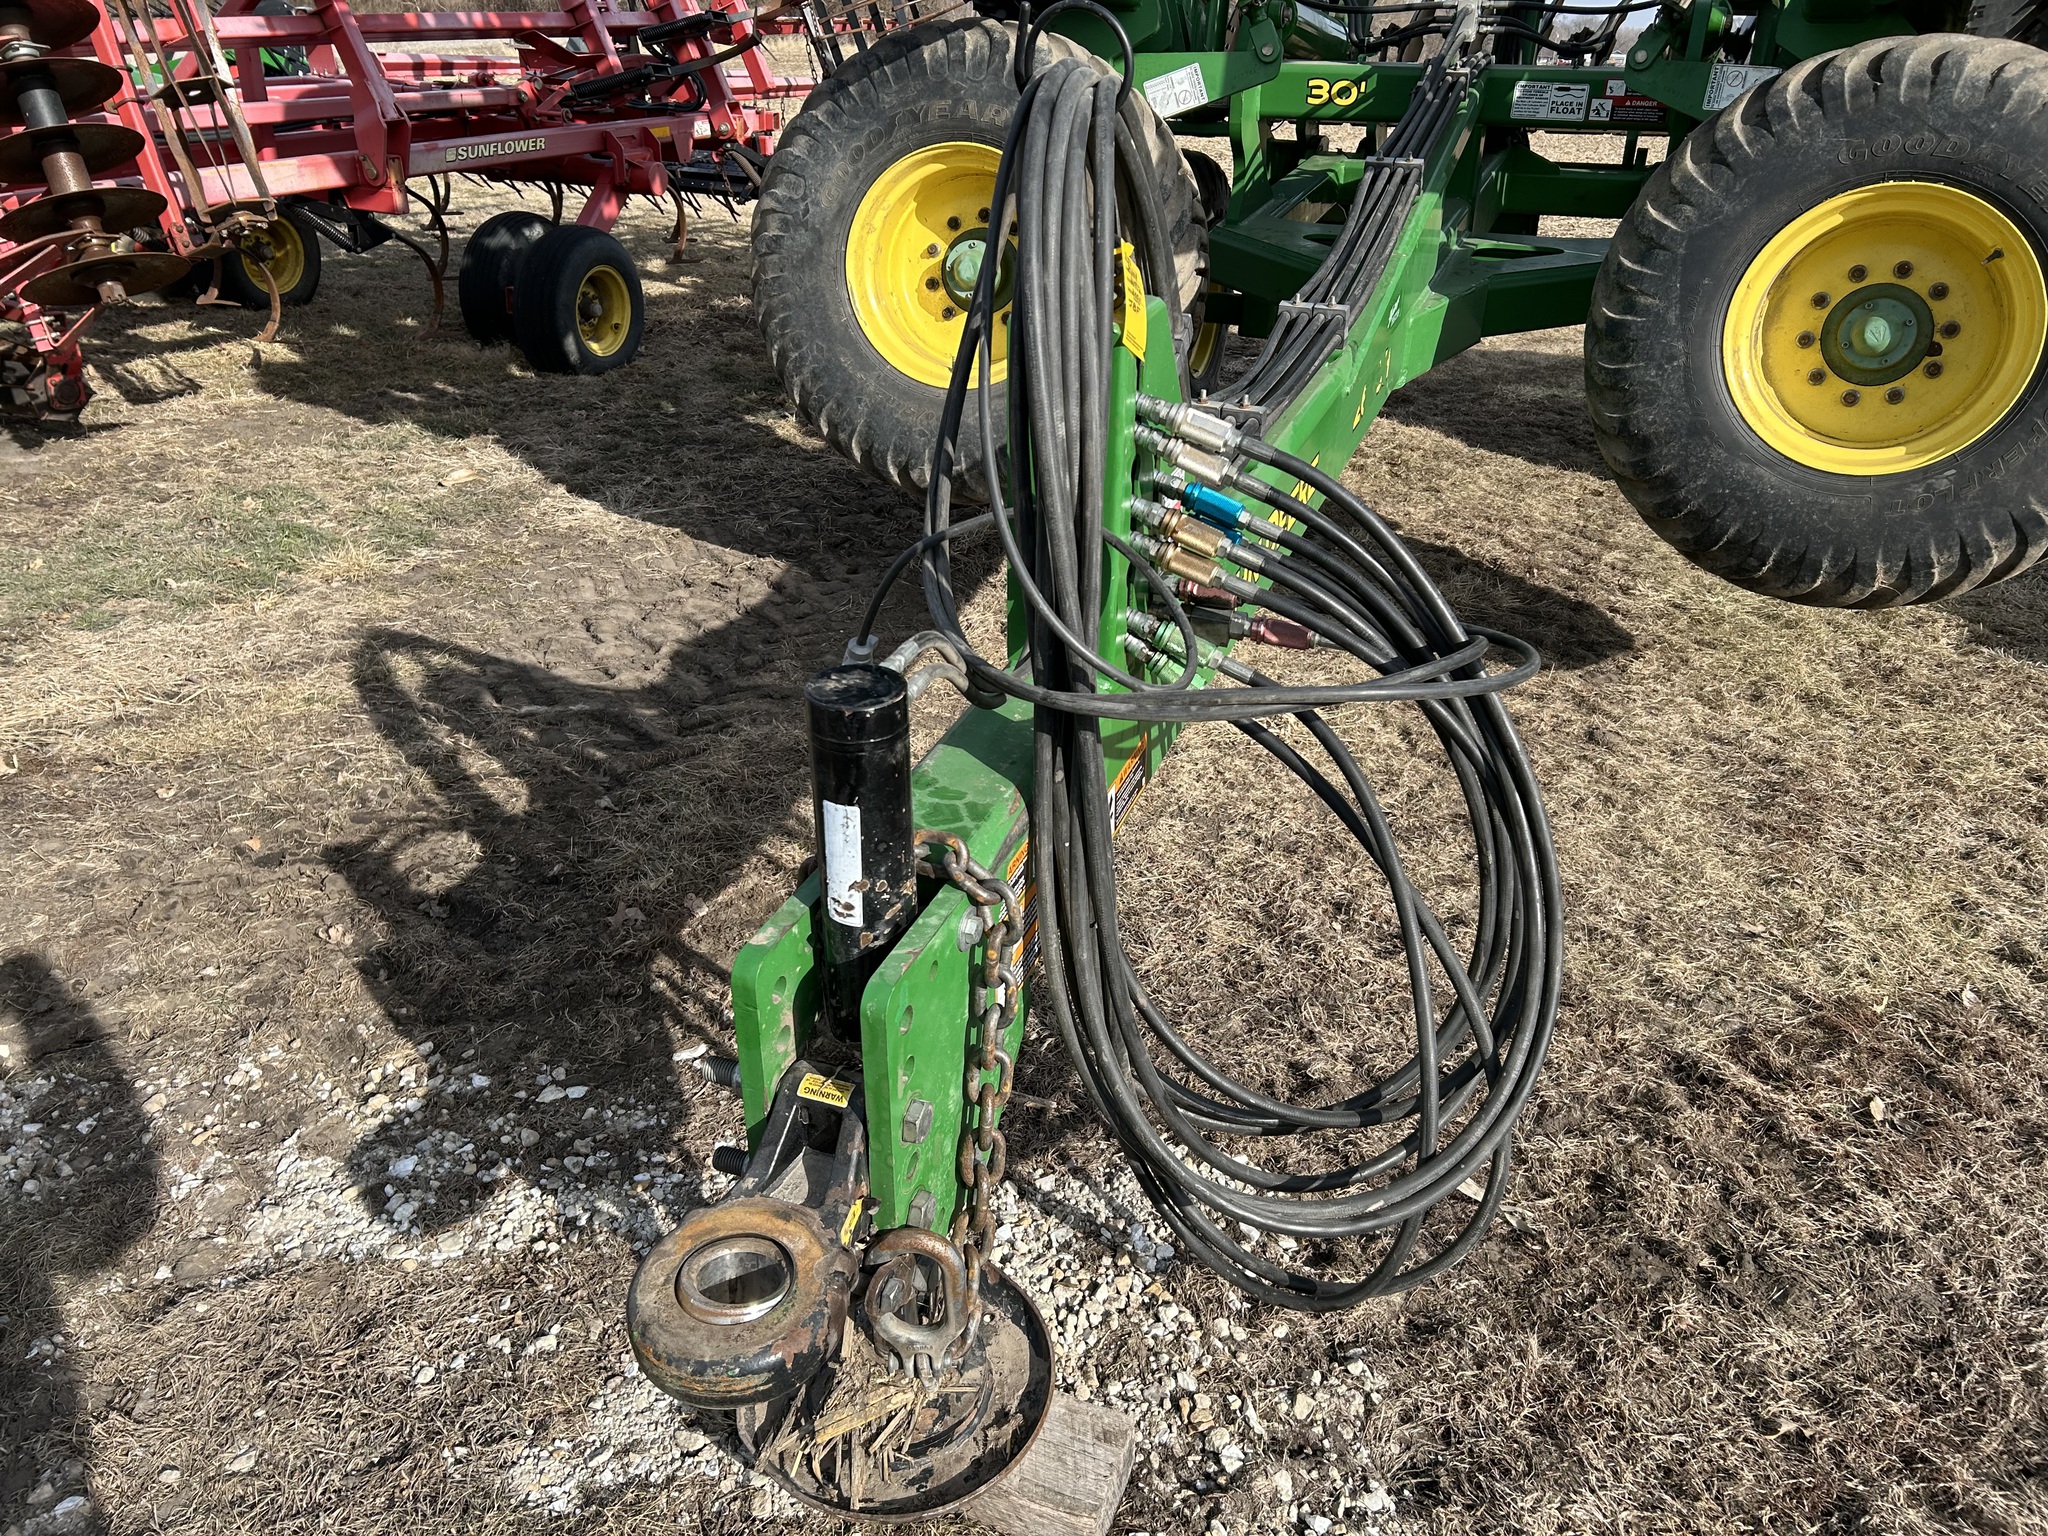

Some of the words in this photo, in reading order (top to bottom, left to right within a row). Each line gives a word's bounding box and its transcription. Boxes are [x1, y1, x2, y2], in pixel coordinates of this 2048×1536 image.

[1193, 66, 1206, 101] IMPORTANT
[1306, 78, 1367, 106] 30'
[1705, 66, 1719, 107] IMPORTANT
[1550, 107, 1583, 115] FLOAT
[457, 138, 546, 160] SUNFLOWER
[820, 100, 1010, 208] GOODYEAR
[1838, 133, 2048, 214] GOODYE
[1884, 406, 2048, 518] PERFLOT
[804, 1086, 843, 1103] WARNING
